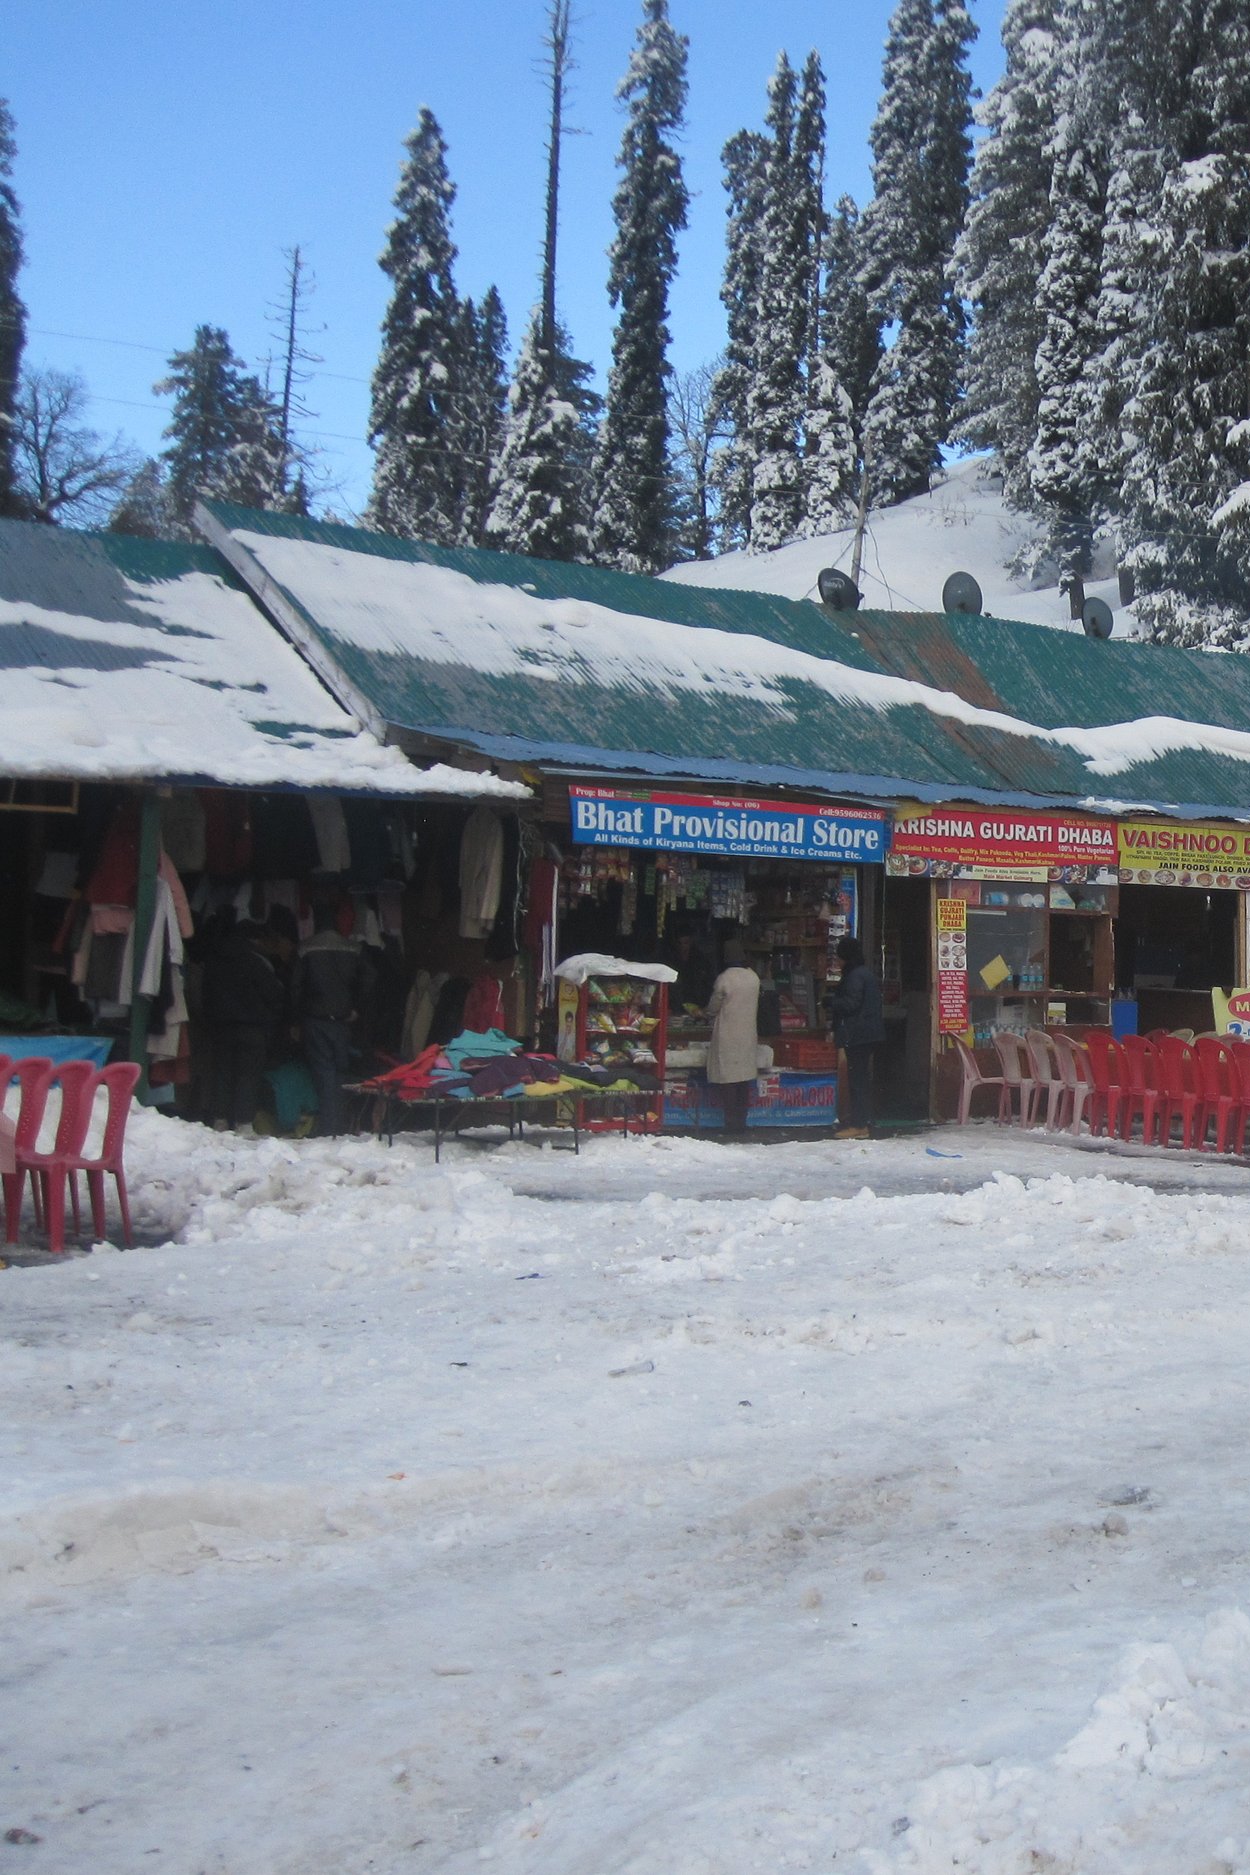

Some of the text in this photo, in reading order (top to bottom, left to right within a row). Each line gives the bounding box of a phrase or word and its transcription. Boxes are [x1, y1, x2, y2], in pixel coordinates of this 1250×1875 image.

[597, 788, 615, 798] Bhat
[712, 799, 730, 808] Shop
[577, 801, 879, 850] Bhat Provisional Store
[895, 818, 1114, 846] KRISHNA GUJRATI DHABA
[594, 833, 862, 860] All Kinds of Kiryana Items, Cold Drink & Ice Creams Etc.
[1086, 846, 1115, 855] Vegetarian
[1123, 829, 1238, 856] VAISHNOO
[1159, 862, 1179, 870] JAIN
[1182, 863, 1210, 872] FOODS
[1213, 865, 1234, 873] ALSO
